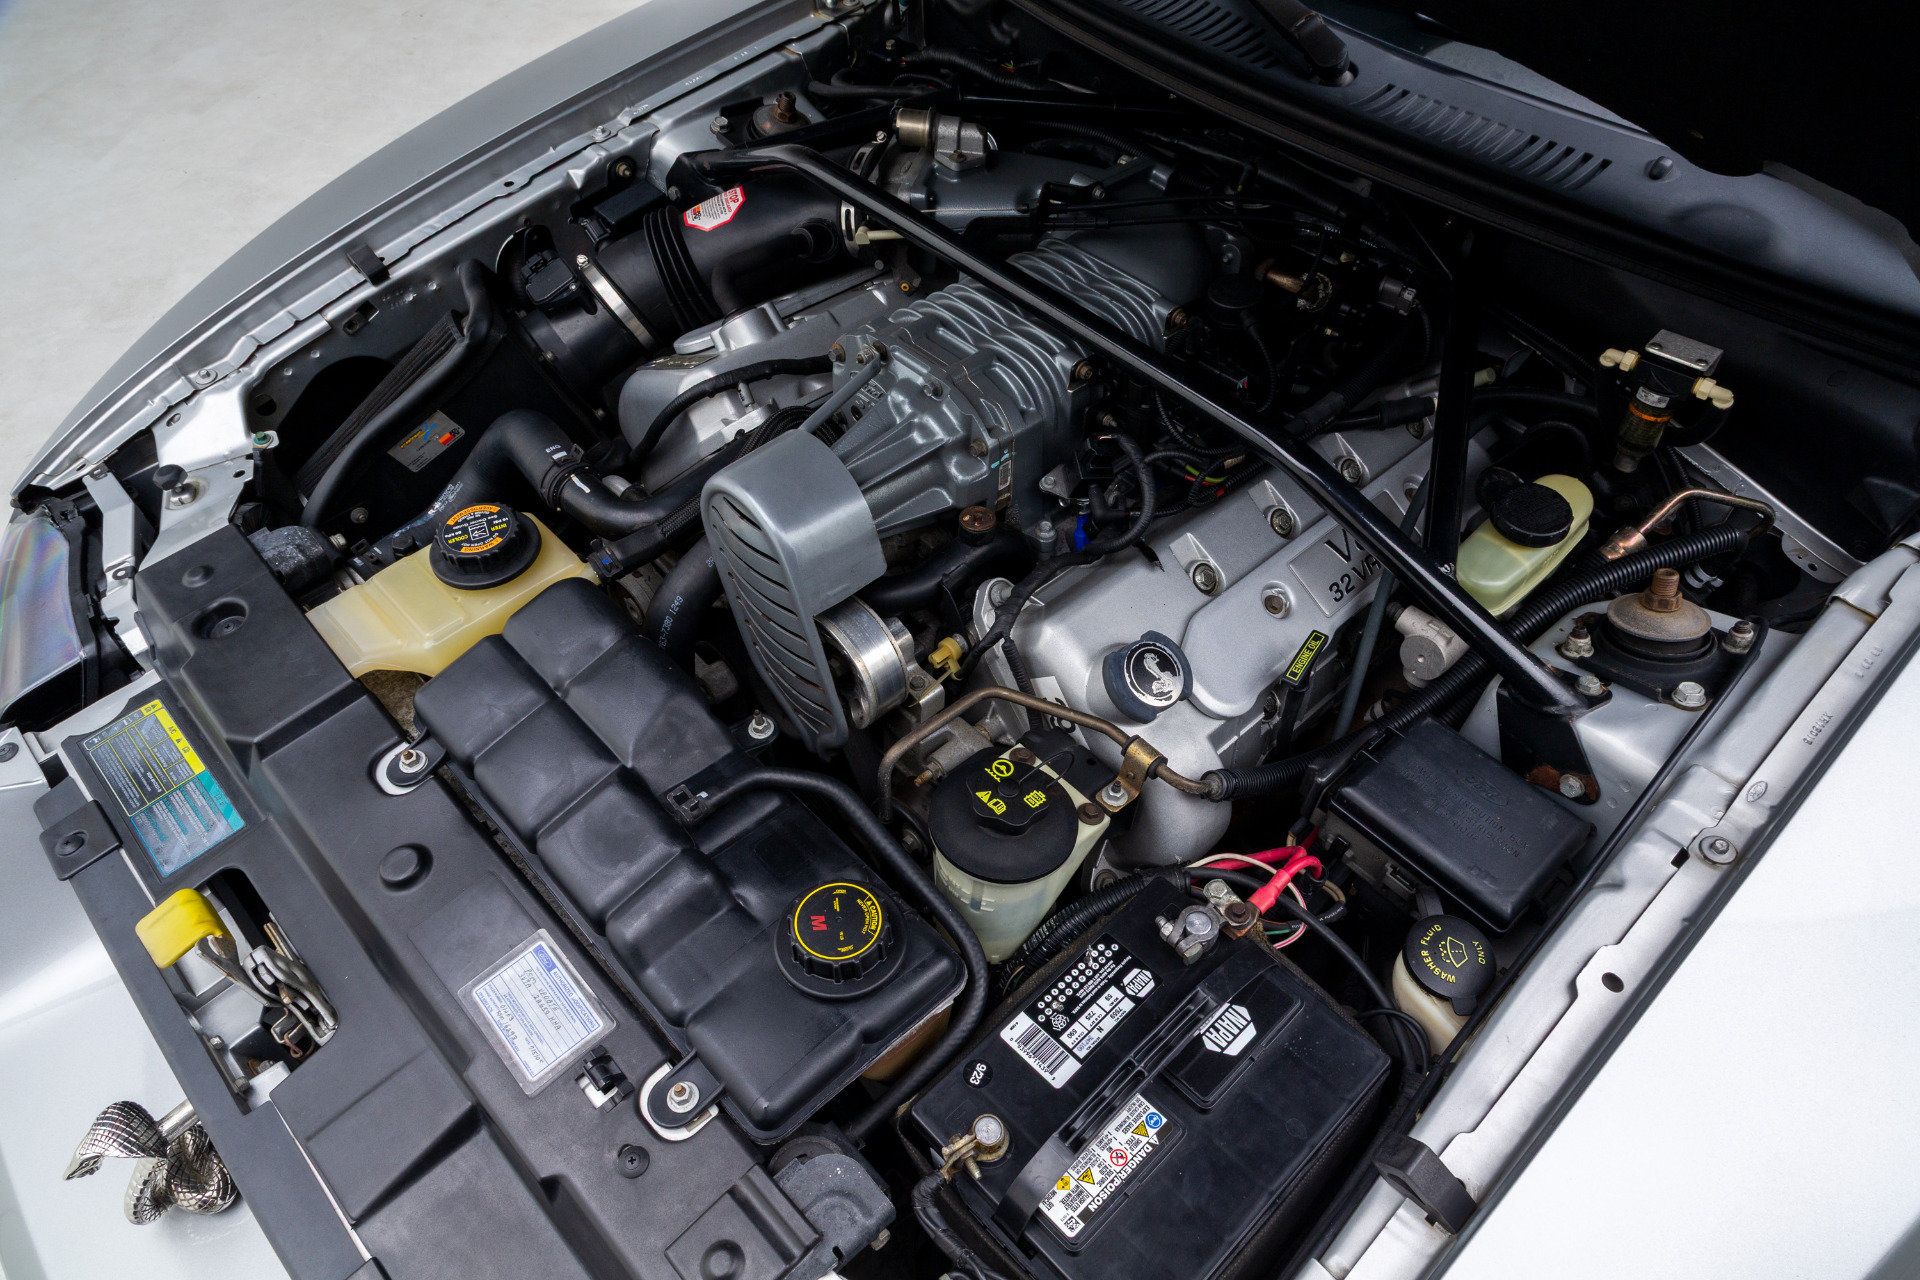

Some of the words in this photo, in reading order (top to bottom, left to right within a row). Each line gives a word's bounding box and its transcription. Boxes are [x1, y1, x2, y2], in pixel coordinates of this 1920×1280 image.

[490, 522, 507, 531] INTER
[447, 534, 468, 543] COOLER
[465, 542, 495, 552] WARNING
[1329, 573, 1356, 603] 32
[669, 594, 684, 616] 1249
[1292, 647, 1312, 674] ENGINE
[1307, 637, 1319, 650] OIL
[856, 898, 867, 911] NEVER
[810, 915, 827, 930] M
[869, 905, 877, 930] CAUTION
[1420, 924, 1442, 946] FLUID
[1472, 940, 1486, 965] ONLY
[1420, 950, 1457, 984] WASHER
[1125, 969, 1151, 995] NAPA
[552, 969, 573, 998] AUTHORIZED
[570, 996, 595, 1030] MODIFICATIONS
[1103, 992, 1113, 1002] 59
[1084, 1009, 1096, 1021] 725
[1108, 1005, 1123, 1020] 7559
[1203, 1006, 1248, 1050] NAPA
[968, 1062, 987, 1085] 9/23
[1130, 1104, 1150, 1123] EXPLOSIVE
[1121, 1121, 1134, 1134] GASES
[1128, 1137, 1142, 1152] SHIELD
[1078, 1152, 1097, 1171] BLINDNESS
[1088, 1156, 1100, 1168] CAUSE
[1096, 1160, 1105, 1169] CAN
[1085, 1142, 1154, 1212] DANGER/POISON
[1098, 1164, 1109, 1175] ACID
[1095, 1169, 1114, 1187] SULFURIC
[1069, 1183, 1080, 1194] WITH
[1062, 1188, 1085, 1210] IMMEDIATELY
[1077, 1192, 1089, 1204] FLUSH
[1044, 1201, 1054, 1211] GET
[1069, 1201, 1081, 1213] EYES
